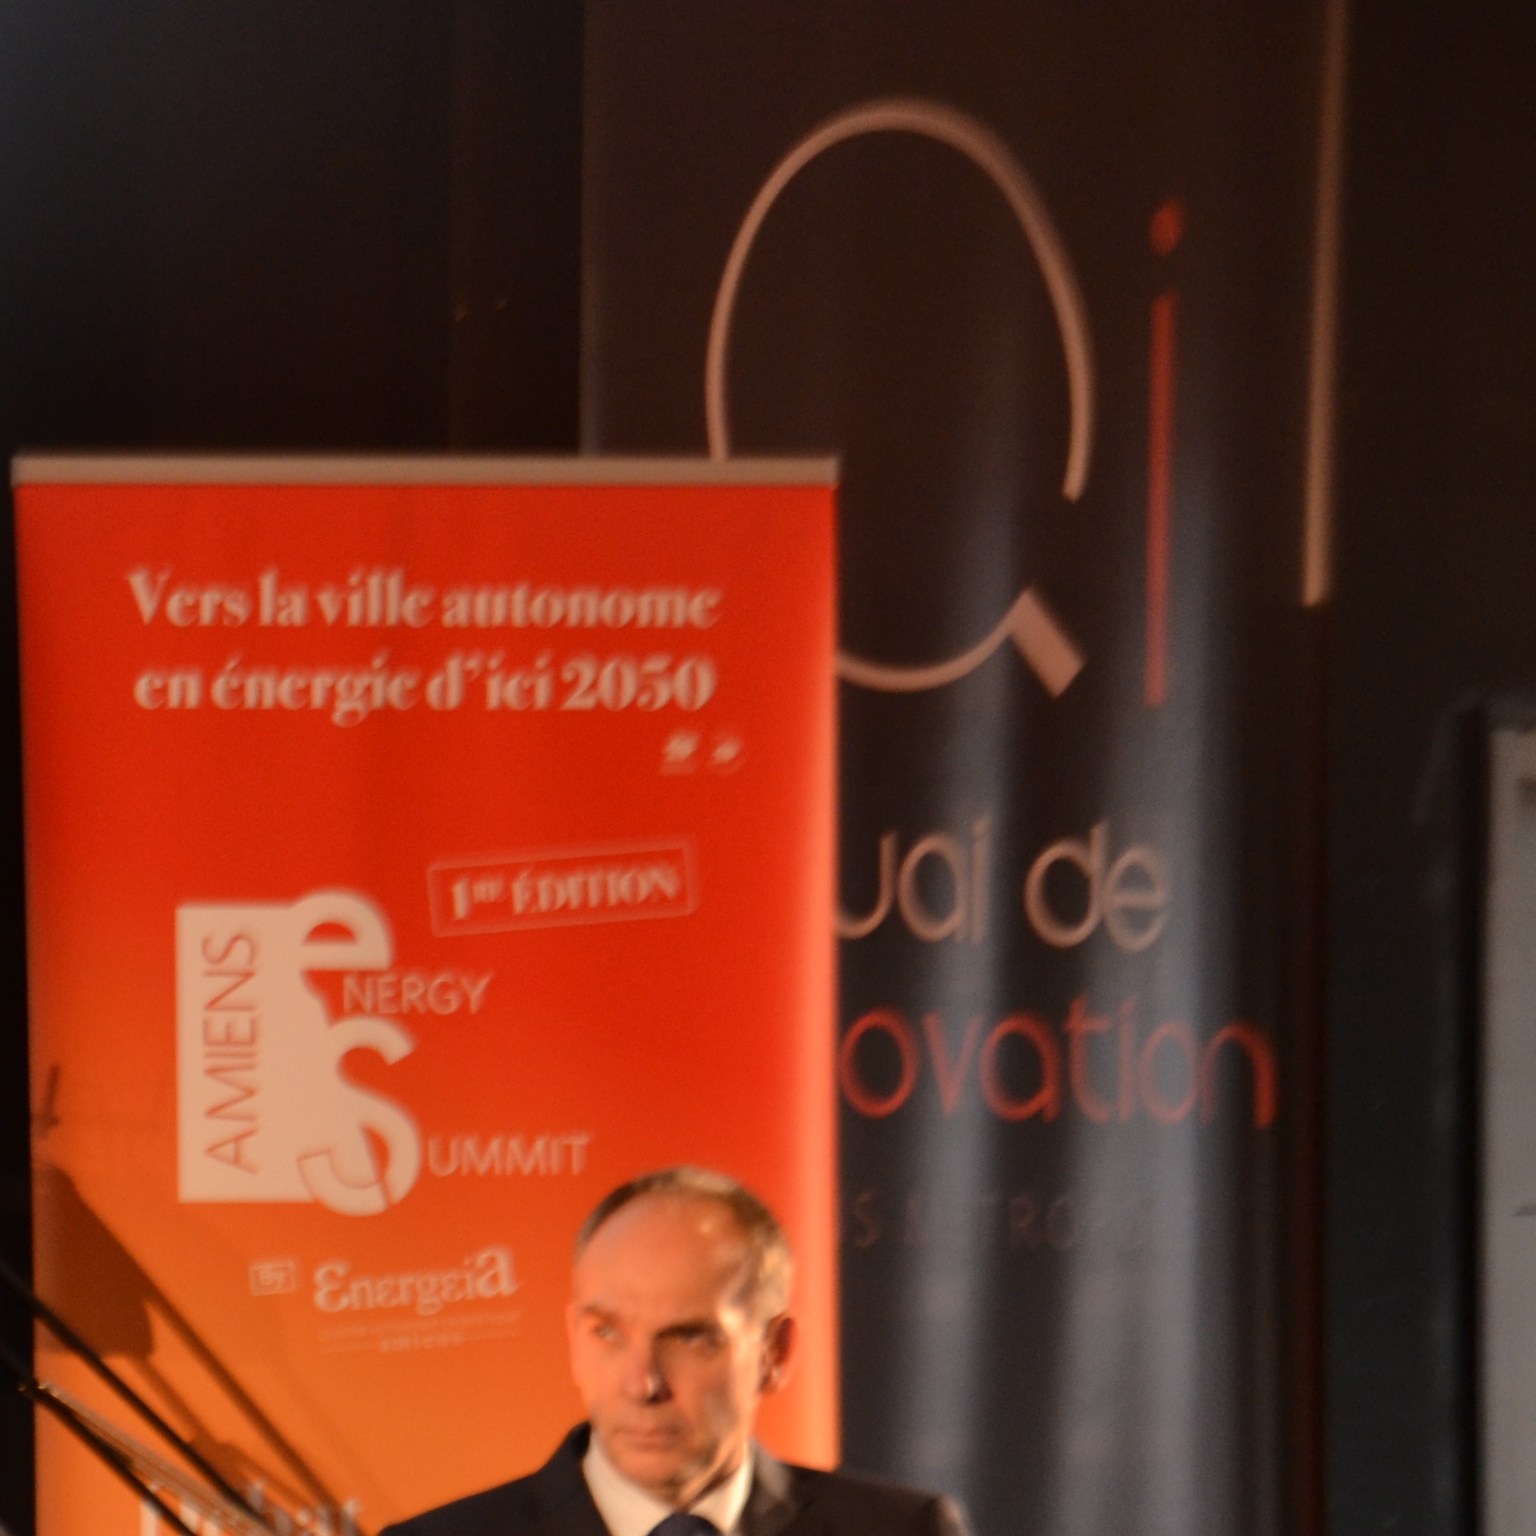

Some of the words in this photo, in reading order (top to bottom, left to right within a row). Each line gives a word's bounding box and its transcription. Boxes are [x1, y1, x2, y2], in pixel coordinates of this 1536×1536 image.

[125, 565, 248, 628] Vers
[258, 565, 308, 628] la
[316, 568, 431, 628] ville
[441, 580, 723, 629] autonome
[133, 665, 203, 710] en
[211, 650, 421, 728] énergie
[559, 652, 717, 711] 2050
[512, 862, 682, 915] ÉDITION
[836, 813, 993, 945] uai
[1026, 818, 1167, 952] de
[201, 930, 257, 1175] AMIENS
[838, 996, 1277, 1131] ovation
[313, 1247, 522, 1317] Energeia
